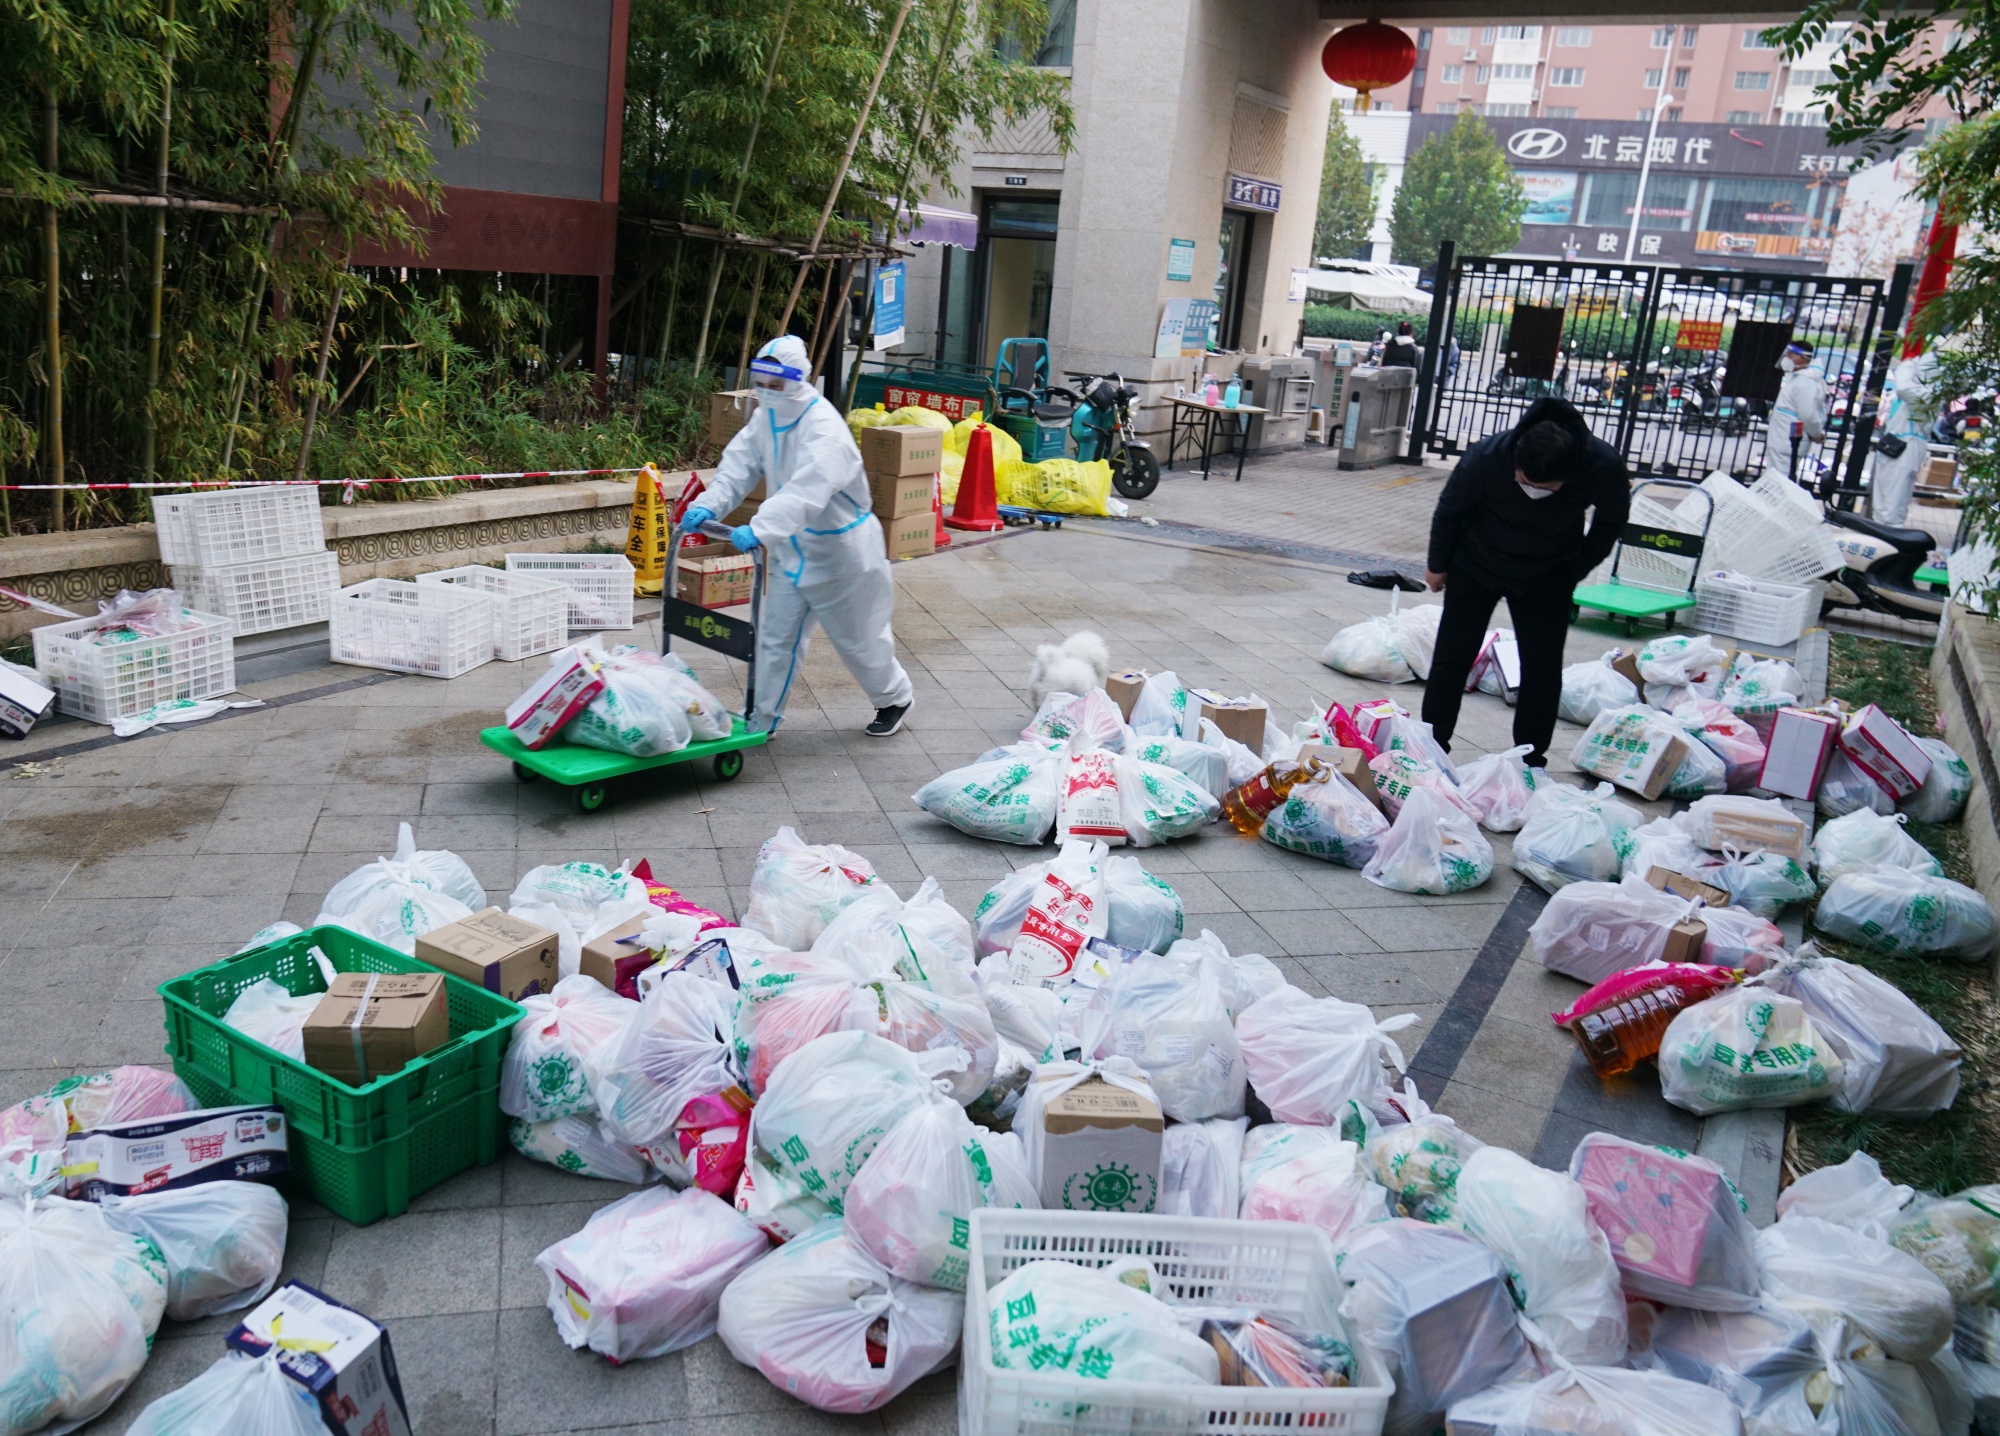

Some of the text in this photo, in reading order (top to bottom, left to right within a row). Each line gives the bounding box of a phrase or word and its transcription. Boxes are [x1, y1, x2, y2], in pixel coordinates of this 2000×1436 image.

[1581, 134, 1713, 164] 北京现代
[1596, 232, 1663, 256] 快保
[888, 388, 961, 412] 窗帘墙布
[630, 515, 646, 552] 车全
[655, 513, 667, 554] 有保障
[1711, 1042, 1817, 1073] 豆芽专用袋
